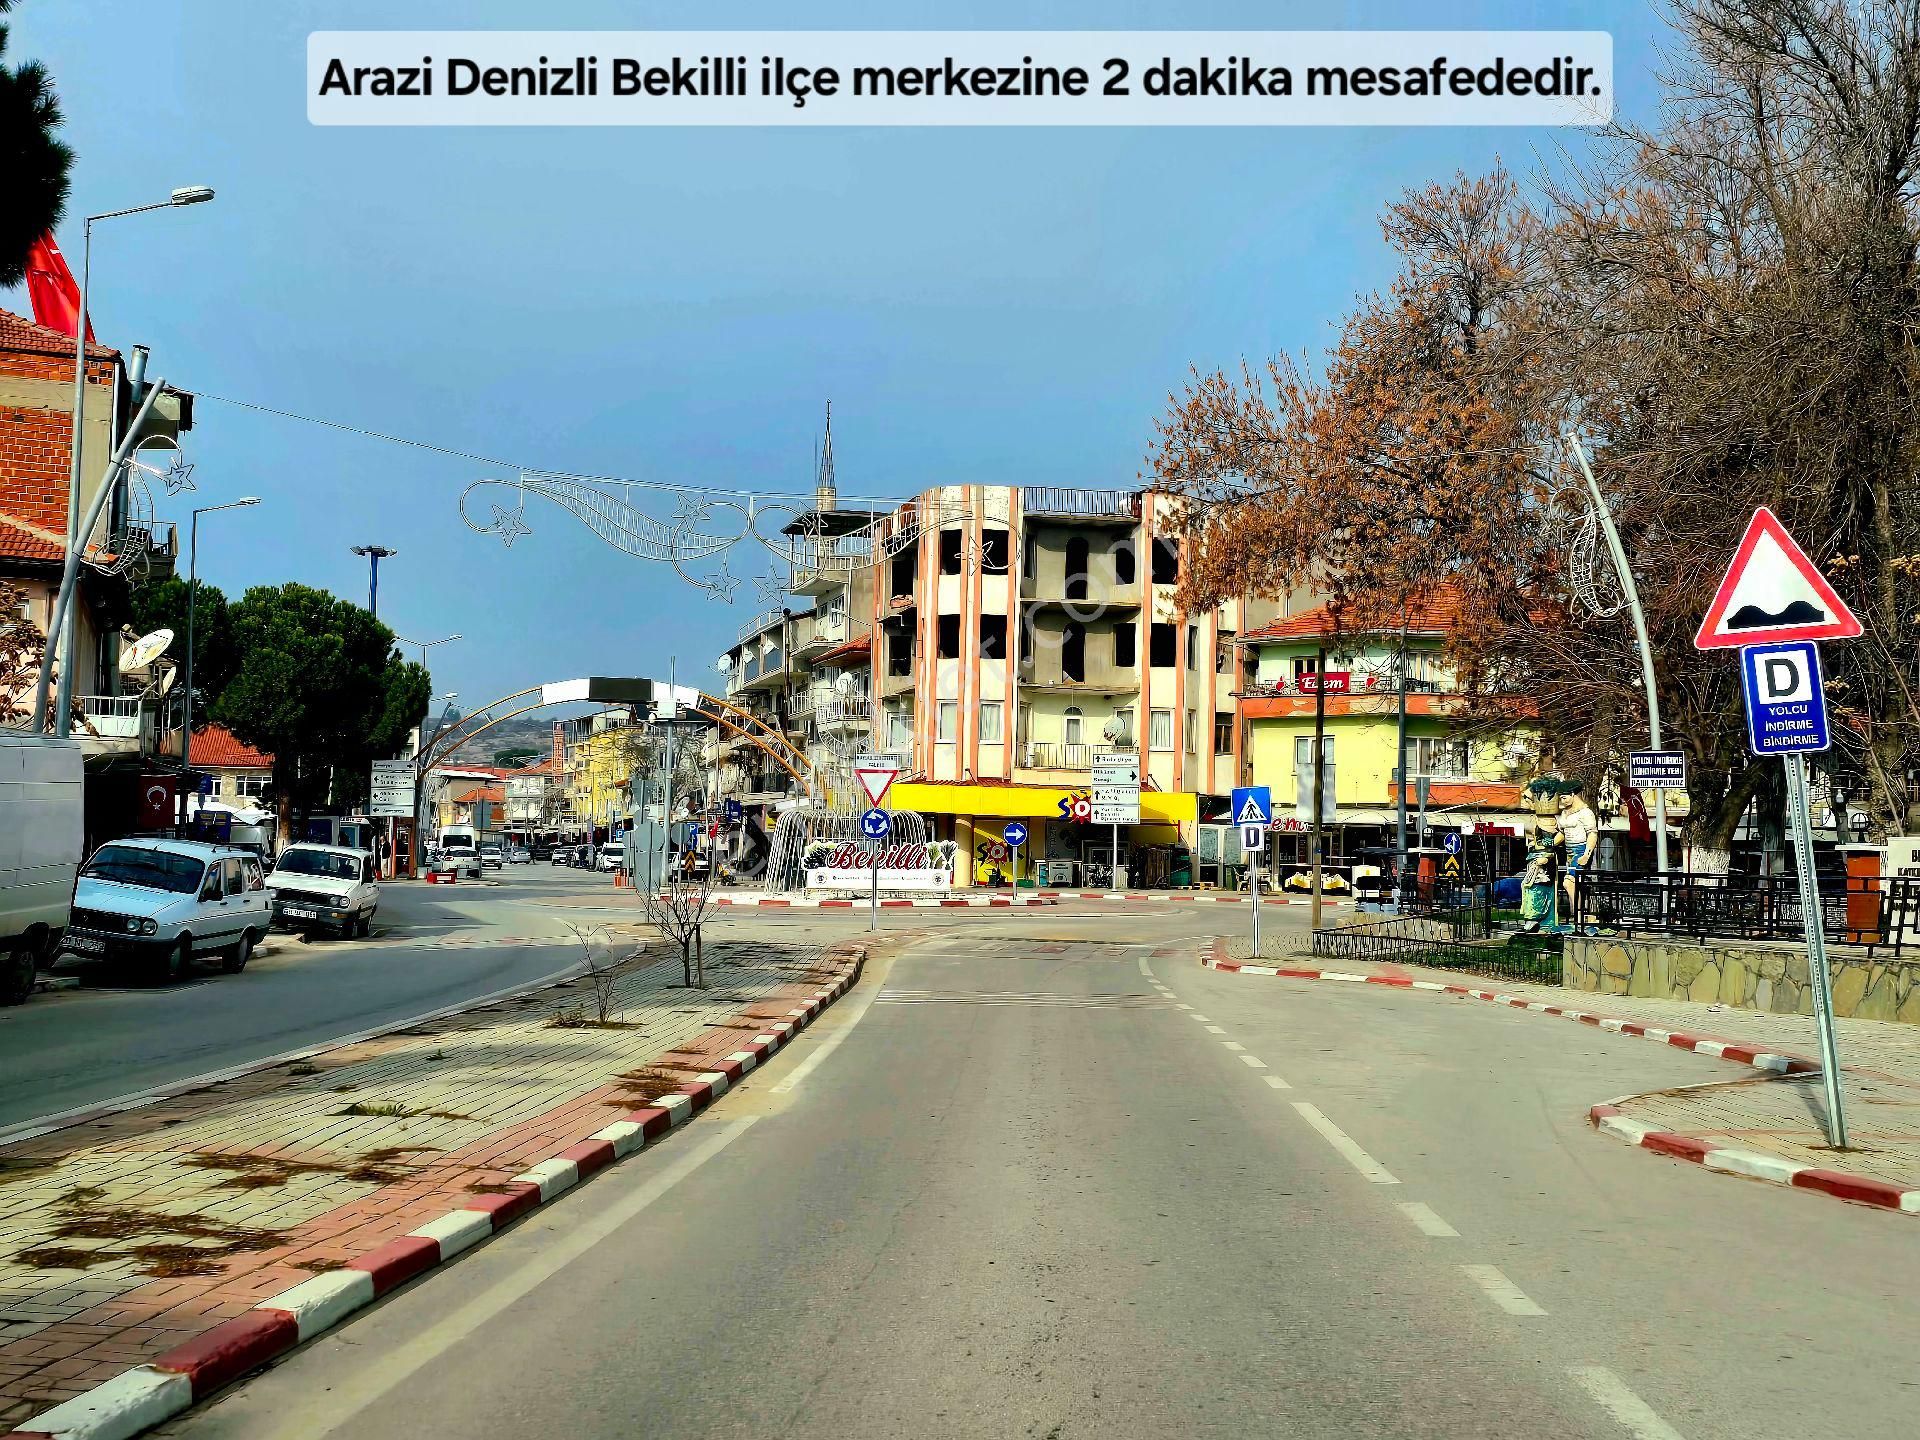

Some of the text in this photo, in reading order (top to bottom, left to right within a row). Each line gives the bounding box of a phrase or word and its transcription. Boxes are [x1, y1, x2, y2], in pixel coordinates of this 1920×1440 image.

[1765, 658, 1799, 698] D
[1769, 704, 1808, 716] YOLCU
[1765, 719, 1814, 732] İNDİRME
[1763, 734, 1819, 747] BİNDİRME
[1632, 756, 1683, 765] YOLCU İNDİRME
[1245, 827, 1260, 848] D
[826, 841, 928, 869] Bekilli
